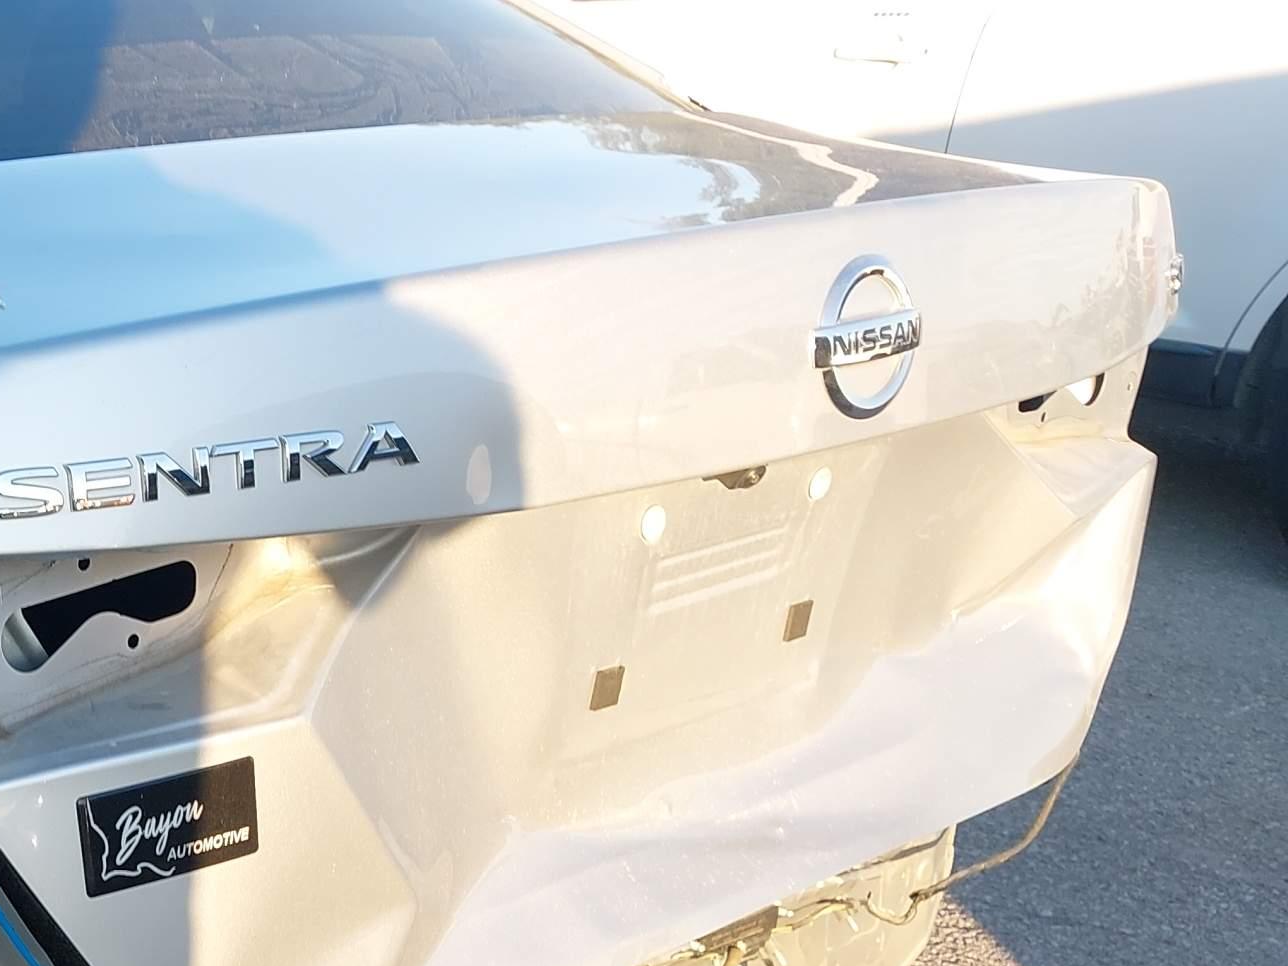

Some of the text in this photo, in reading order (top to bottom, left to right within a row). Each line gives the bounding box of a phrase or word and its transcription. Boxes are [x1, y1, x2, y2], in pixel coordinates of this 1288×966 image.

[832, 318, 921, 356] NISSAN
[115, 799, 204, 866] Bayon
[166, 826, 250, 862] AUTOMOTIVE
